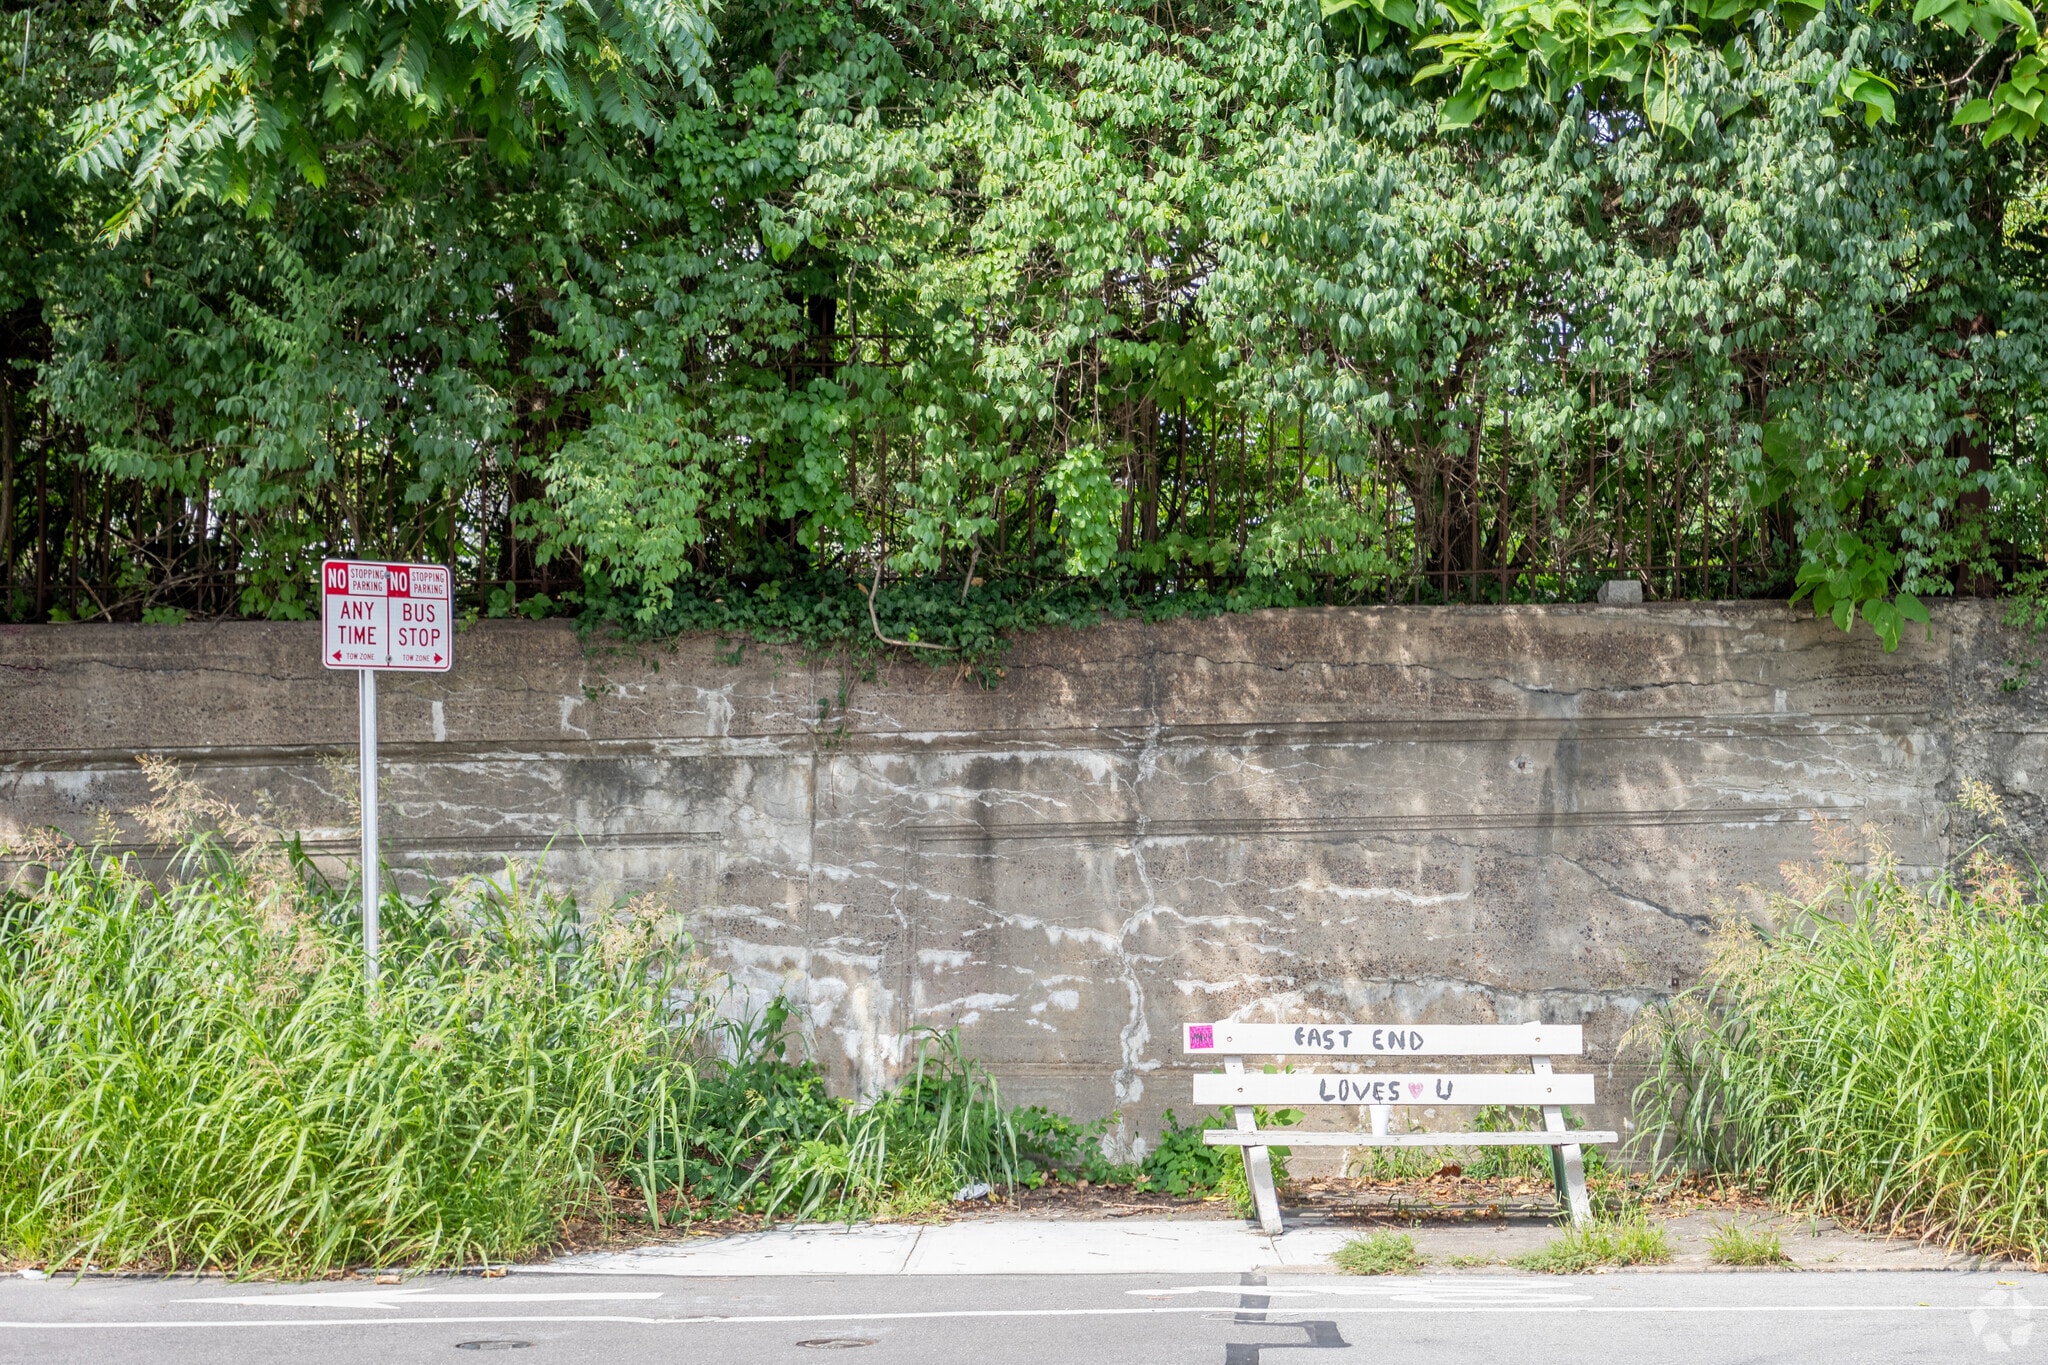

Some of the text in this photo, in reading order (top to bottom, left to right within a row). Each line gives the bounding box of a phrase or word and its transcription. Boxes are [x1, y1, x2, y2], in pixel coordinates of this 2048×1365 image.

[328, 568, 346, 589] NO
[350, 569, 384, 580] STOPPING
[390, 571, 408, 592] NO
[411, 572, 444, 583] STOPPING
[352, 581, 383, 592] PARKING
[413, 584, 443, 595] PARKING
[340, 601, 374, 620] ANY
[402, 603, 435, 623] BUS
[338, 625, 377, 645] TIME
[398, 627, 440, 647] STOP
[346, 652, 375, 661] TOW ZONE
[415, 654, 430, 662] ZONE
[1294, 1026, 1424, 1051] EAST END
[1318, 1078, 1454, 1102] LOVES U
